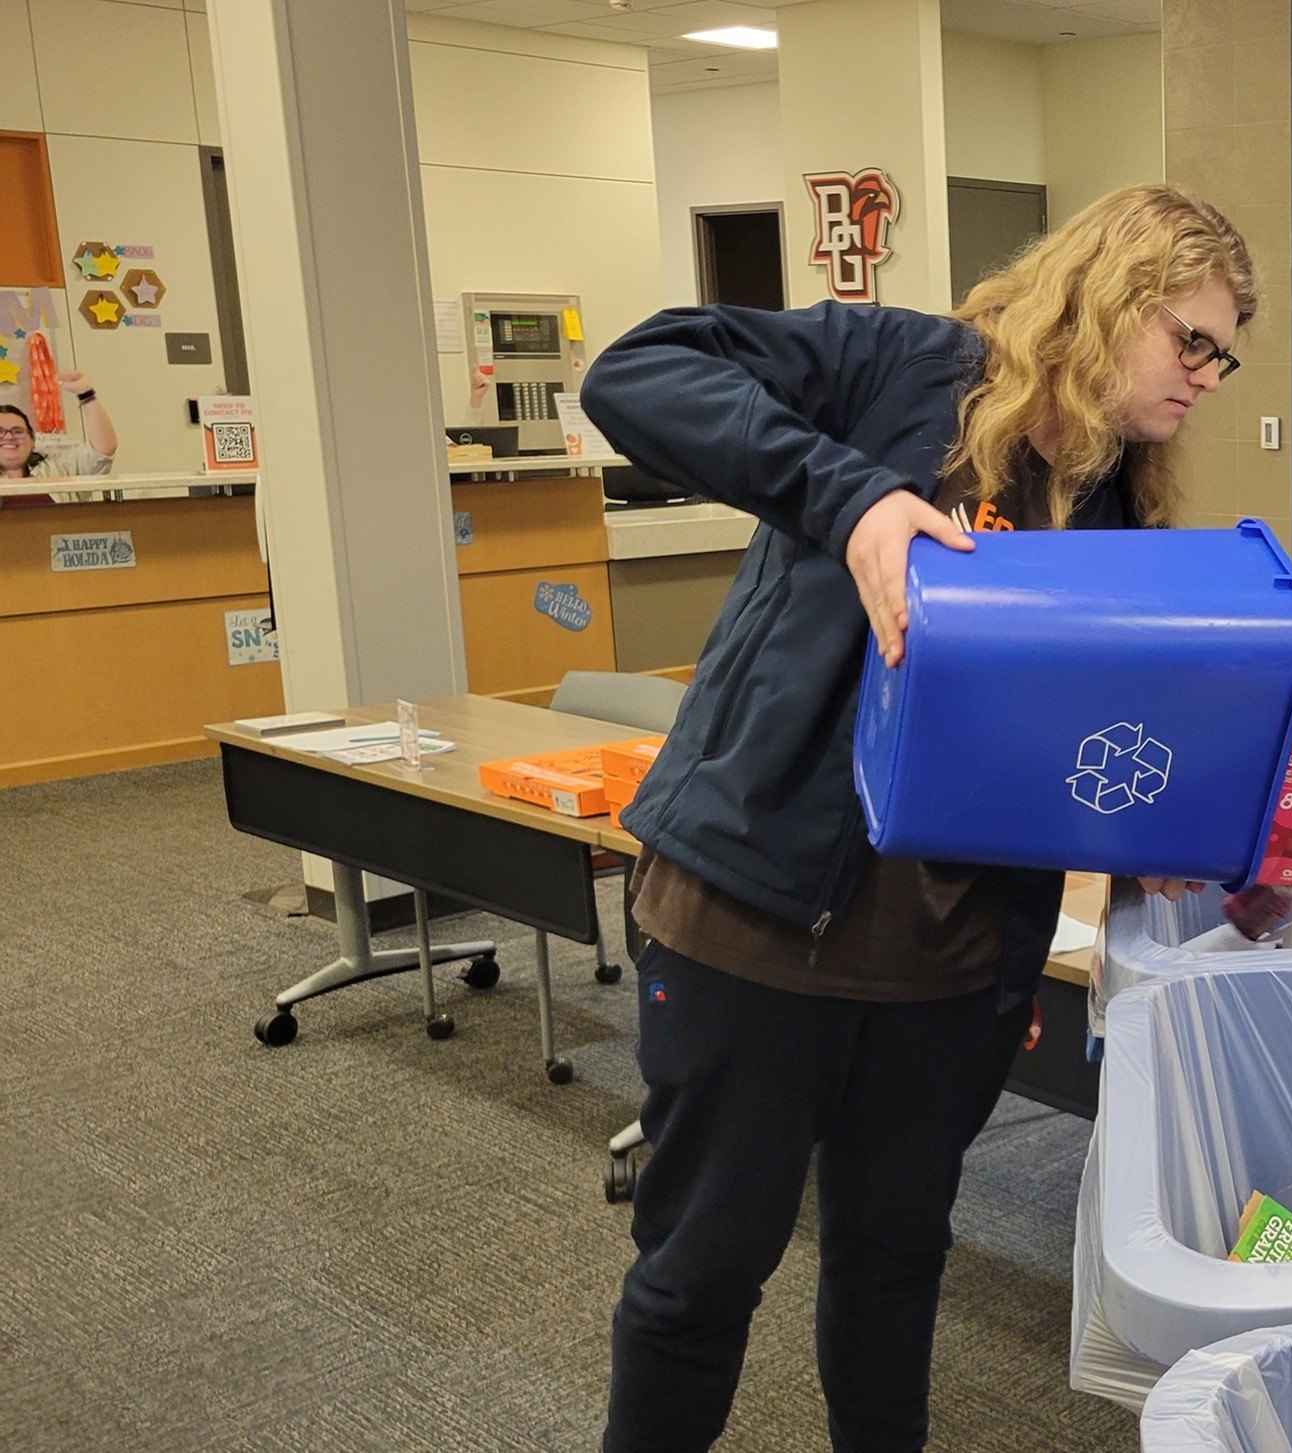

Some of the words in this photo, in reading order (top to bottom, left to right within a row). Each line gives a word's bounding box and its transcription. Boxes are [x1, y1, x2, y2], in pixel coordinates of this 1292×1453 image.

[814, 184, 865, 291] BG
[72, 537, 108, 551] HAPPY
[548, 600, 587, 627] Winter
[554, 591, 588, 613] HELLO
